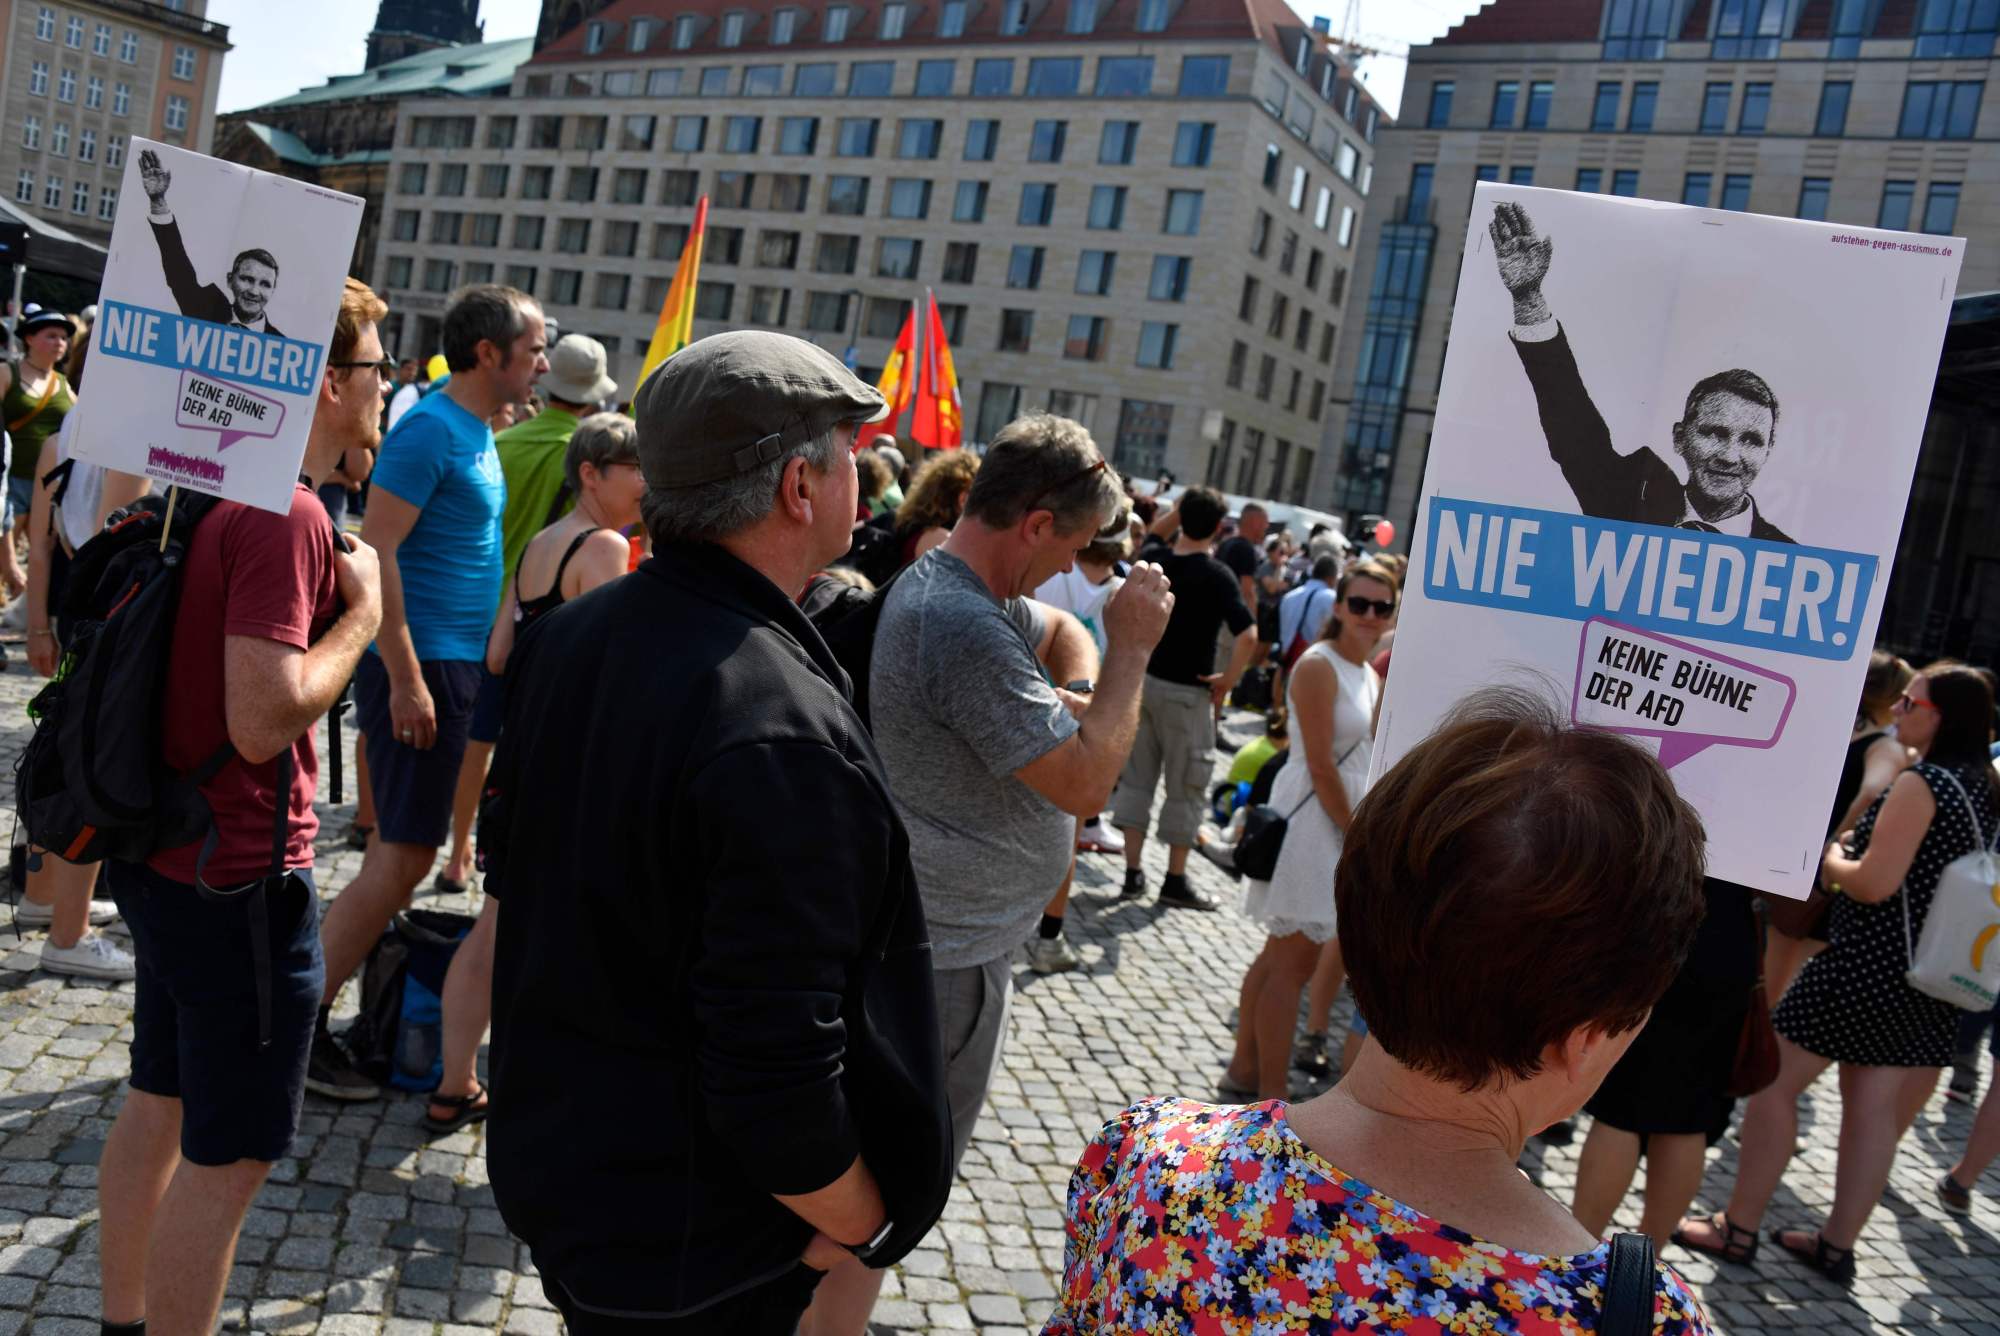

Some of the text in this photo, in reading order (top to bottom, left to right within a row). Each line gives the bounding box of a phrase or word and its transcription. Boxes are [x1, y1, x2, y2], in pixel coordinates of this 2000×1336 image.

[1831, 234, 1953, 257] aufstehen-gegen-rassismus.de
[103, 306, 316, 389] NIE WIEDER!
[182, 396, 233, 428] DER AFD
[188, 378, 268, 421] KEINE BÜHNE
[1431, 509, 1860, 647] NIE WIEDER!
[1585, 672, 1685, 728] DER AFD
[1597, 635, 1757, 713] KEINE BÜHNE
